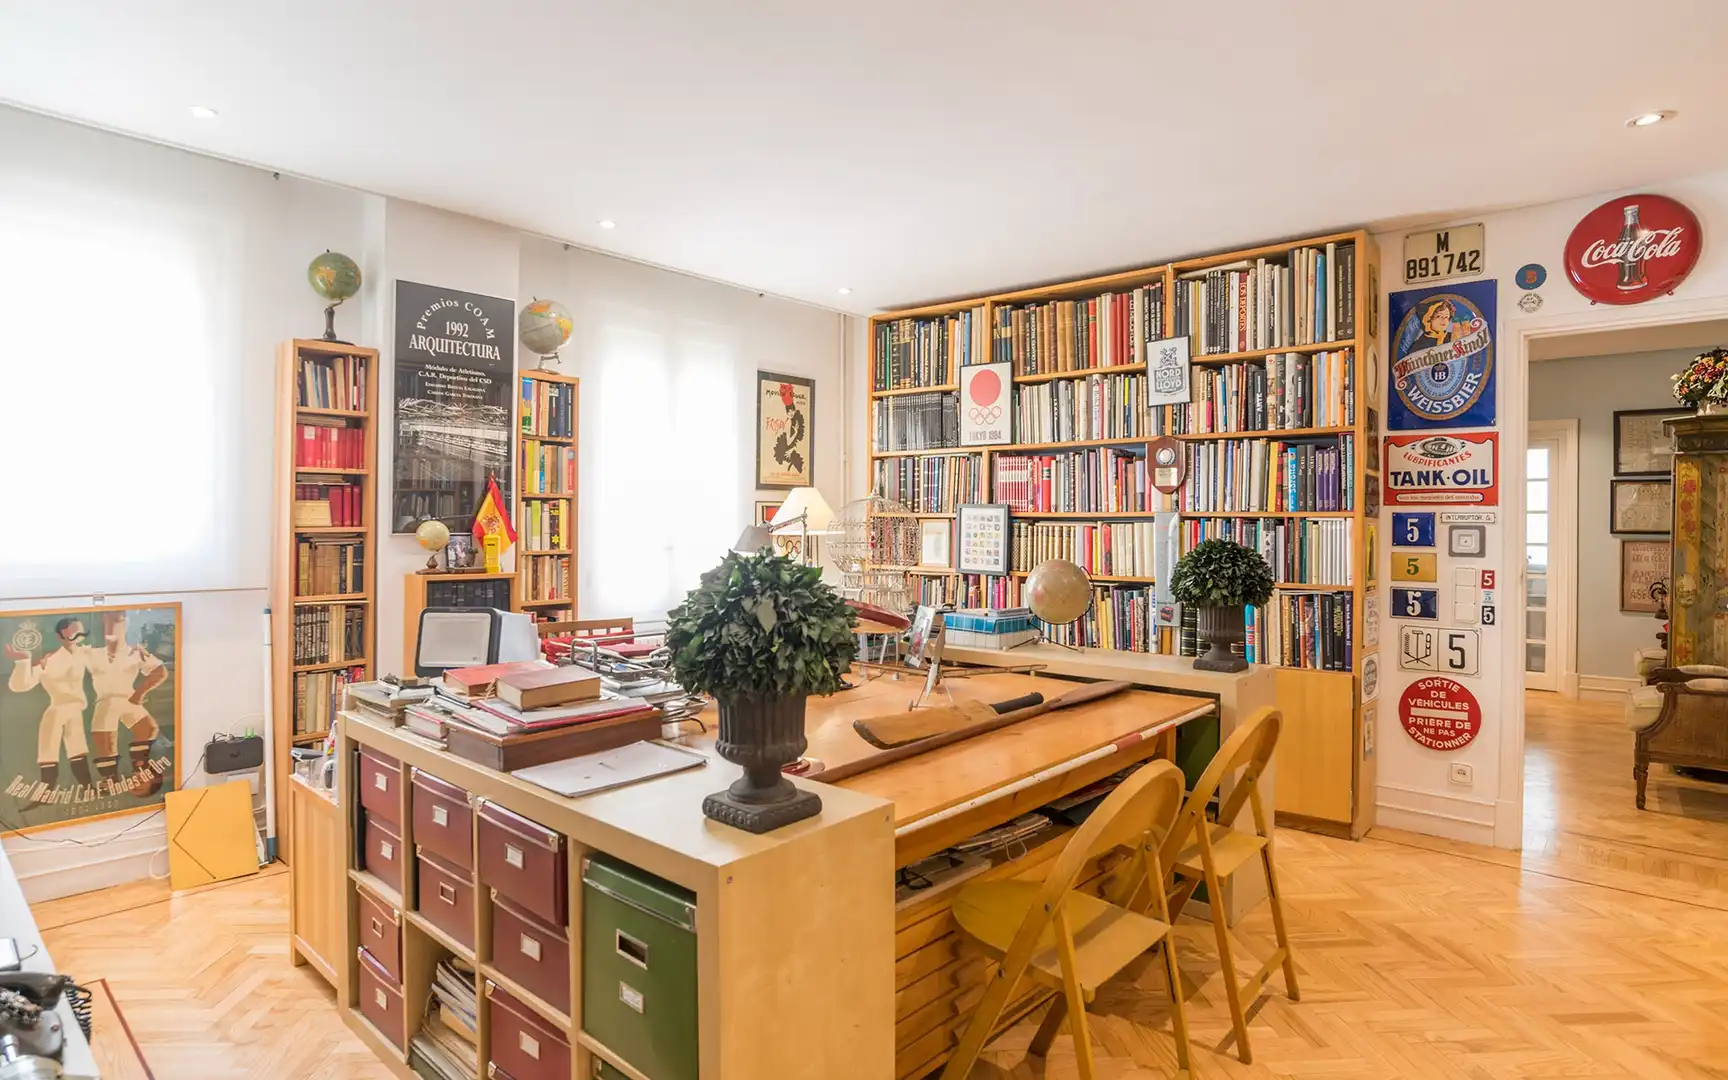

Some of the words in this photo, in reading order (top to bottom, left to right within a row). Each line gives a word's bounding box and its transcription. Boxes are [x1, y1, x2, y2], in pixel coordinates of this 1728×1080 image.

[1436, 231, 1449, 254] M
[1406, 249, 1481, 280] 891742
[416, 298, 459, 330] Premios
[464, 301, 496, 340] COAM
[445, 320, 469, 338] 1992
[408, 333, 501, 360] ARQUITECTURA
[439, 373, 468, 381] Deportivo
[1156, 369, 1181, 379] NORD
[1407, 372, 1482, 413] WEISSBIER
[1403, 451, 1472, 467] LUBRIFICANTES
[1407, 518, 1419, 543] 5
[1406, 558, 1419, 575] 5
[1482, 573, 1493, 586] 5
[1406, 591, 1421, 616] 5
[1483, 607, 1493, 624] 5
[1448, 633, 1466, 670] 5
[1418, 680, 1460, 693] SORTIE
[1430, 690, 1446, 698] DE
[1438, 729, 1456, 737] PAS
[1455, 721, 1471, 730] DE
[1408, 727, 1472, 748] STATIONNER
[5, 775, 37, 799] Real
[30, 781, 75, 804] Madrid
[140, 766, 155, 783] de
[148, 756, 172, 775] Oro
